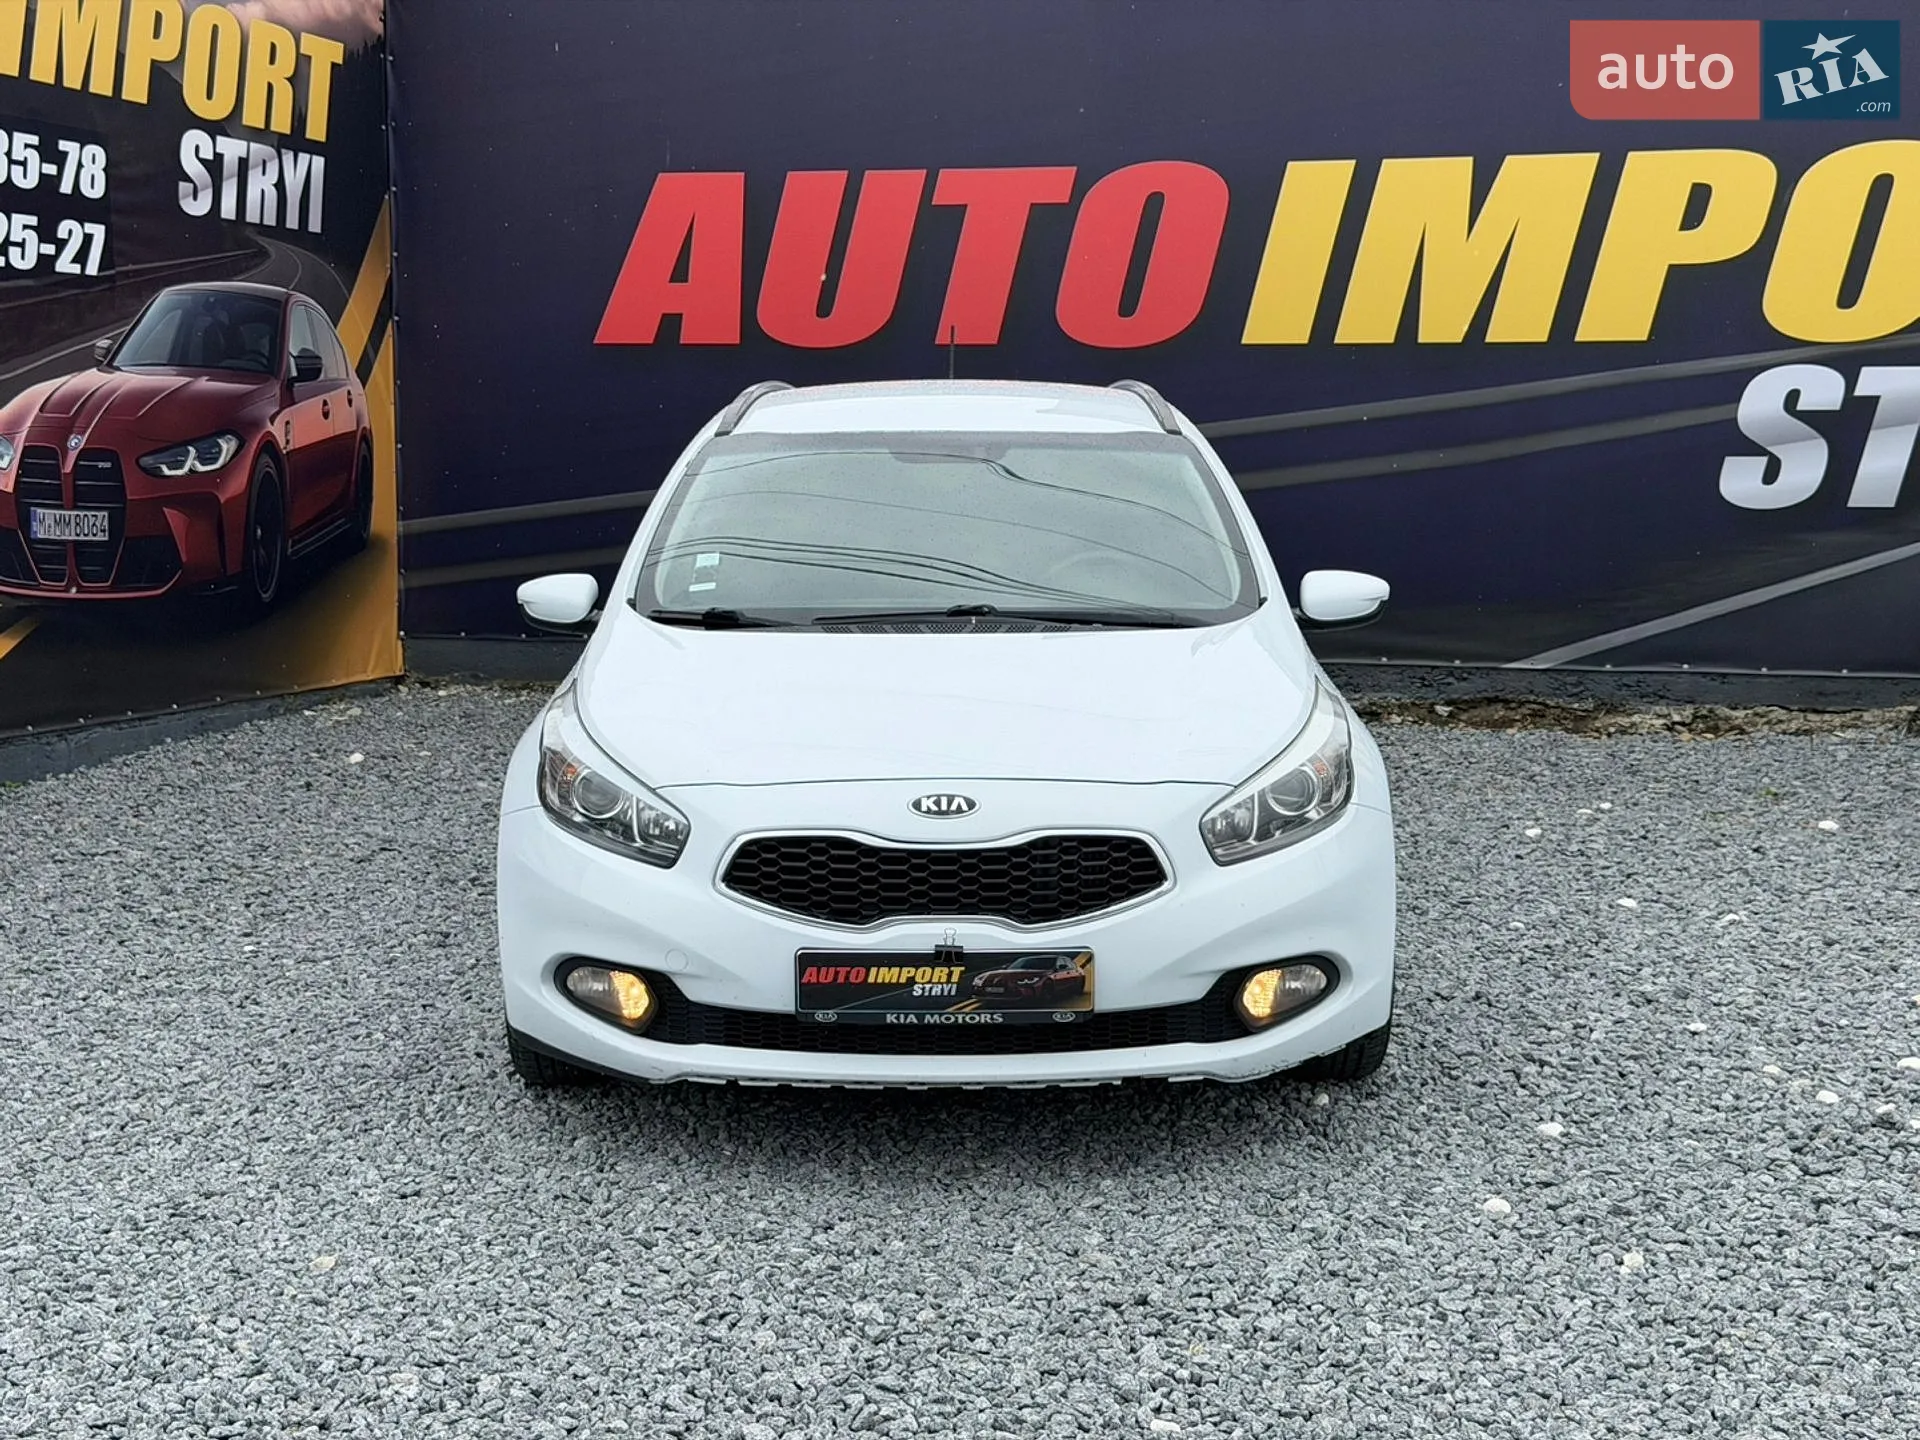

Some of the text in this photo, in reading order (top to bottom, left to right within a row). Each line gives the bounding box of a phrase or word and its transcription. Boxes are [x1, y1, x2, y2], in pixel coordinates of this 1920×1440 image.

[178, 129, 326, 233] STRYI
[921, 796, 969, 812] KIA
[912, 984, 957, 996] STRYI
[886, 1013, 1004, 1024] KIA MOTORS
